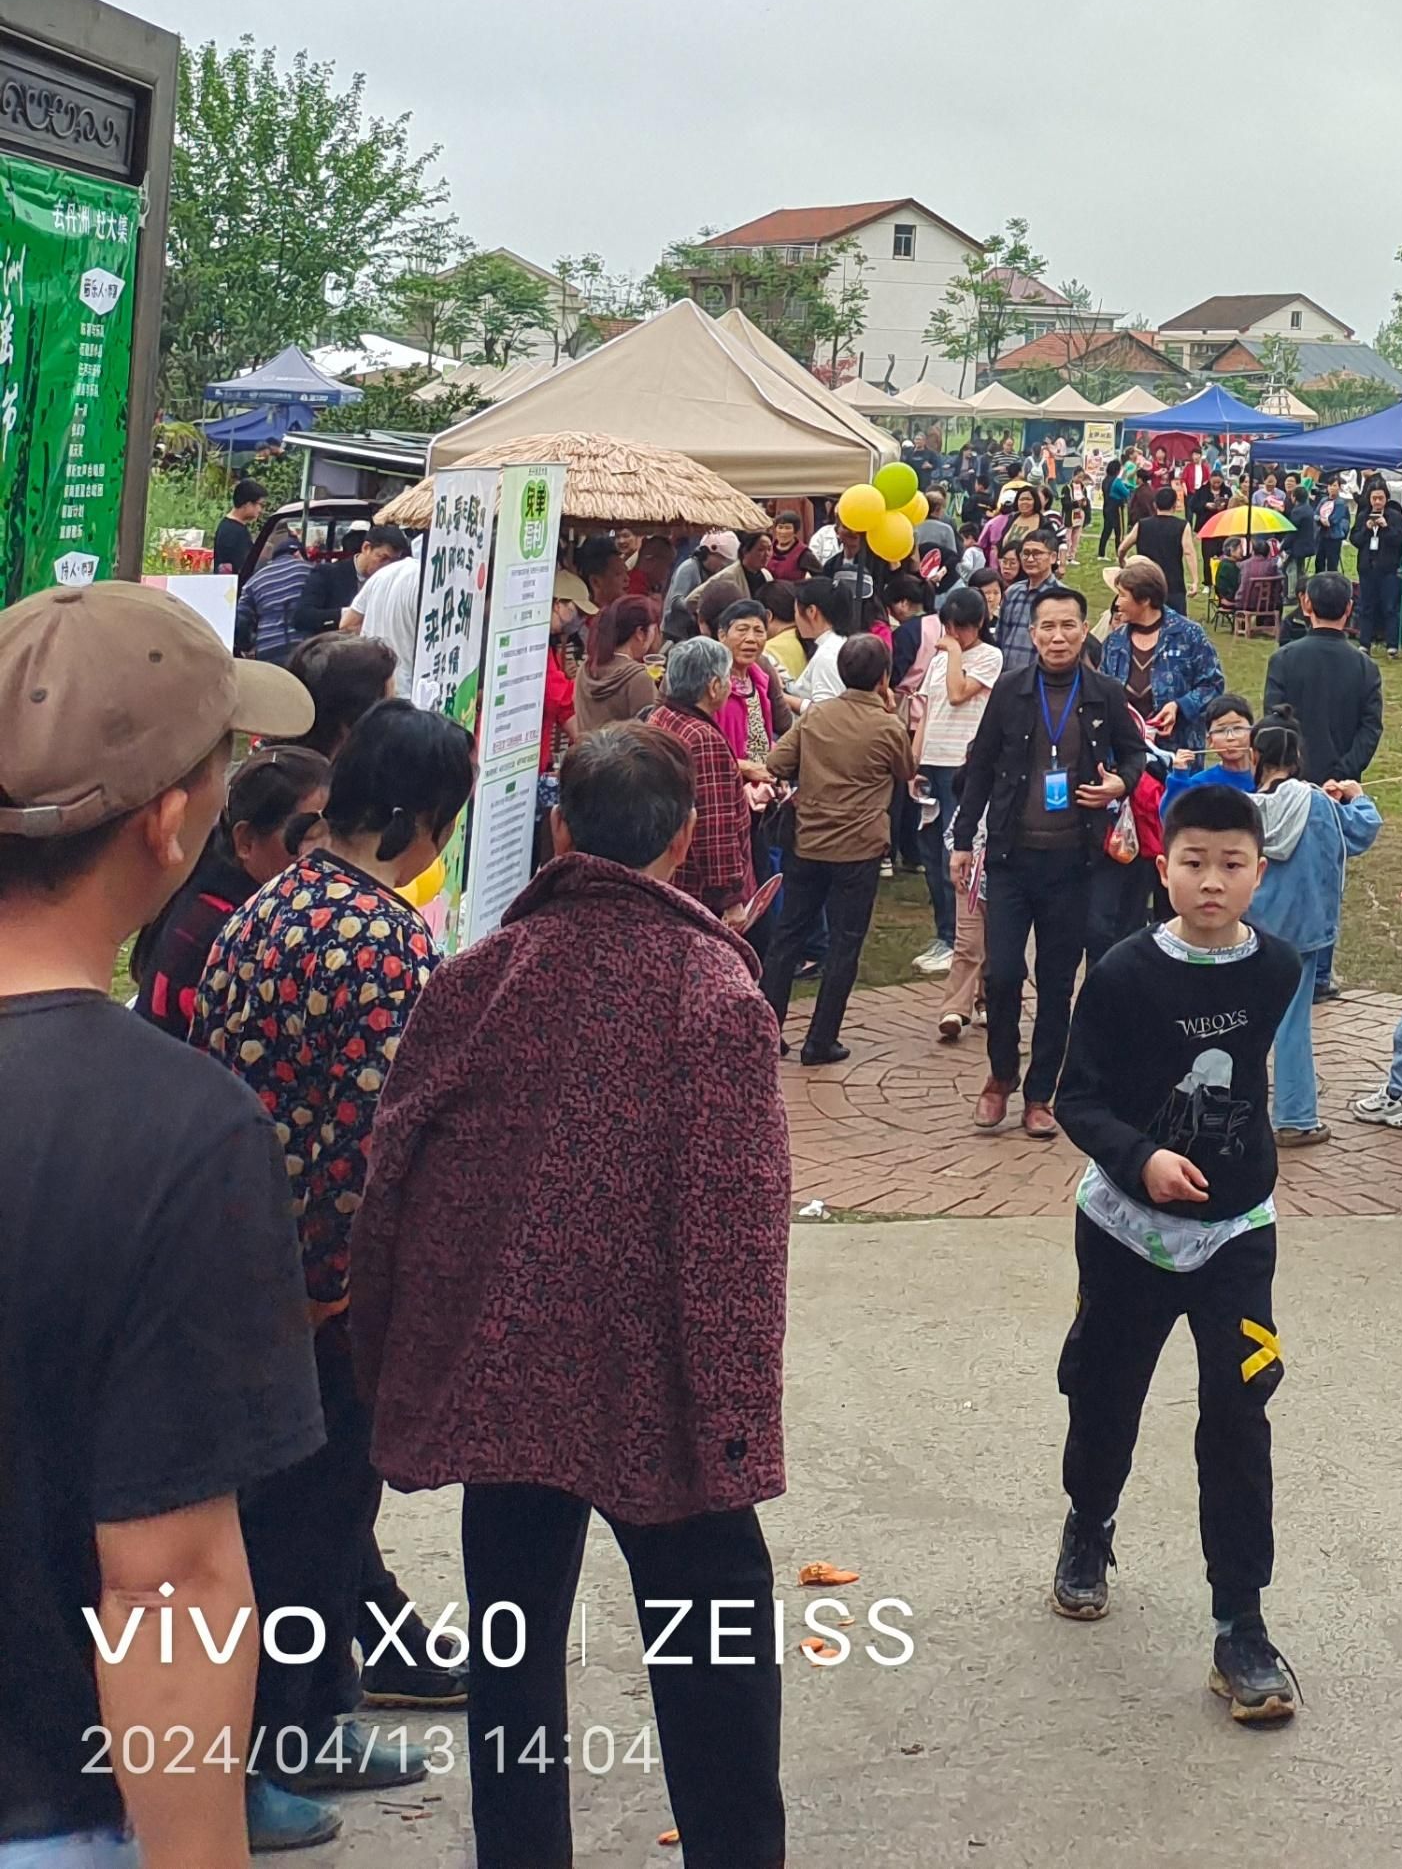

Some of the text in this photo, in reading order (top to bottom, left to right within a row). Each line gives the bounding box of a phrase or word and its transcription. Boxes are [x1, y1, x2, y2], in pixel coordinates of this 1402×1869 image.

[52, 200, 90, 234] 去丹洲
[525, 486, 546, 518] 免单
